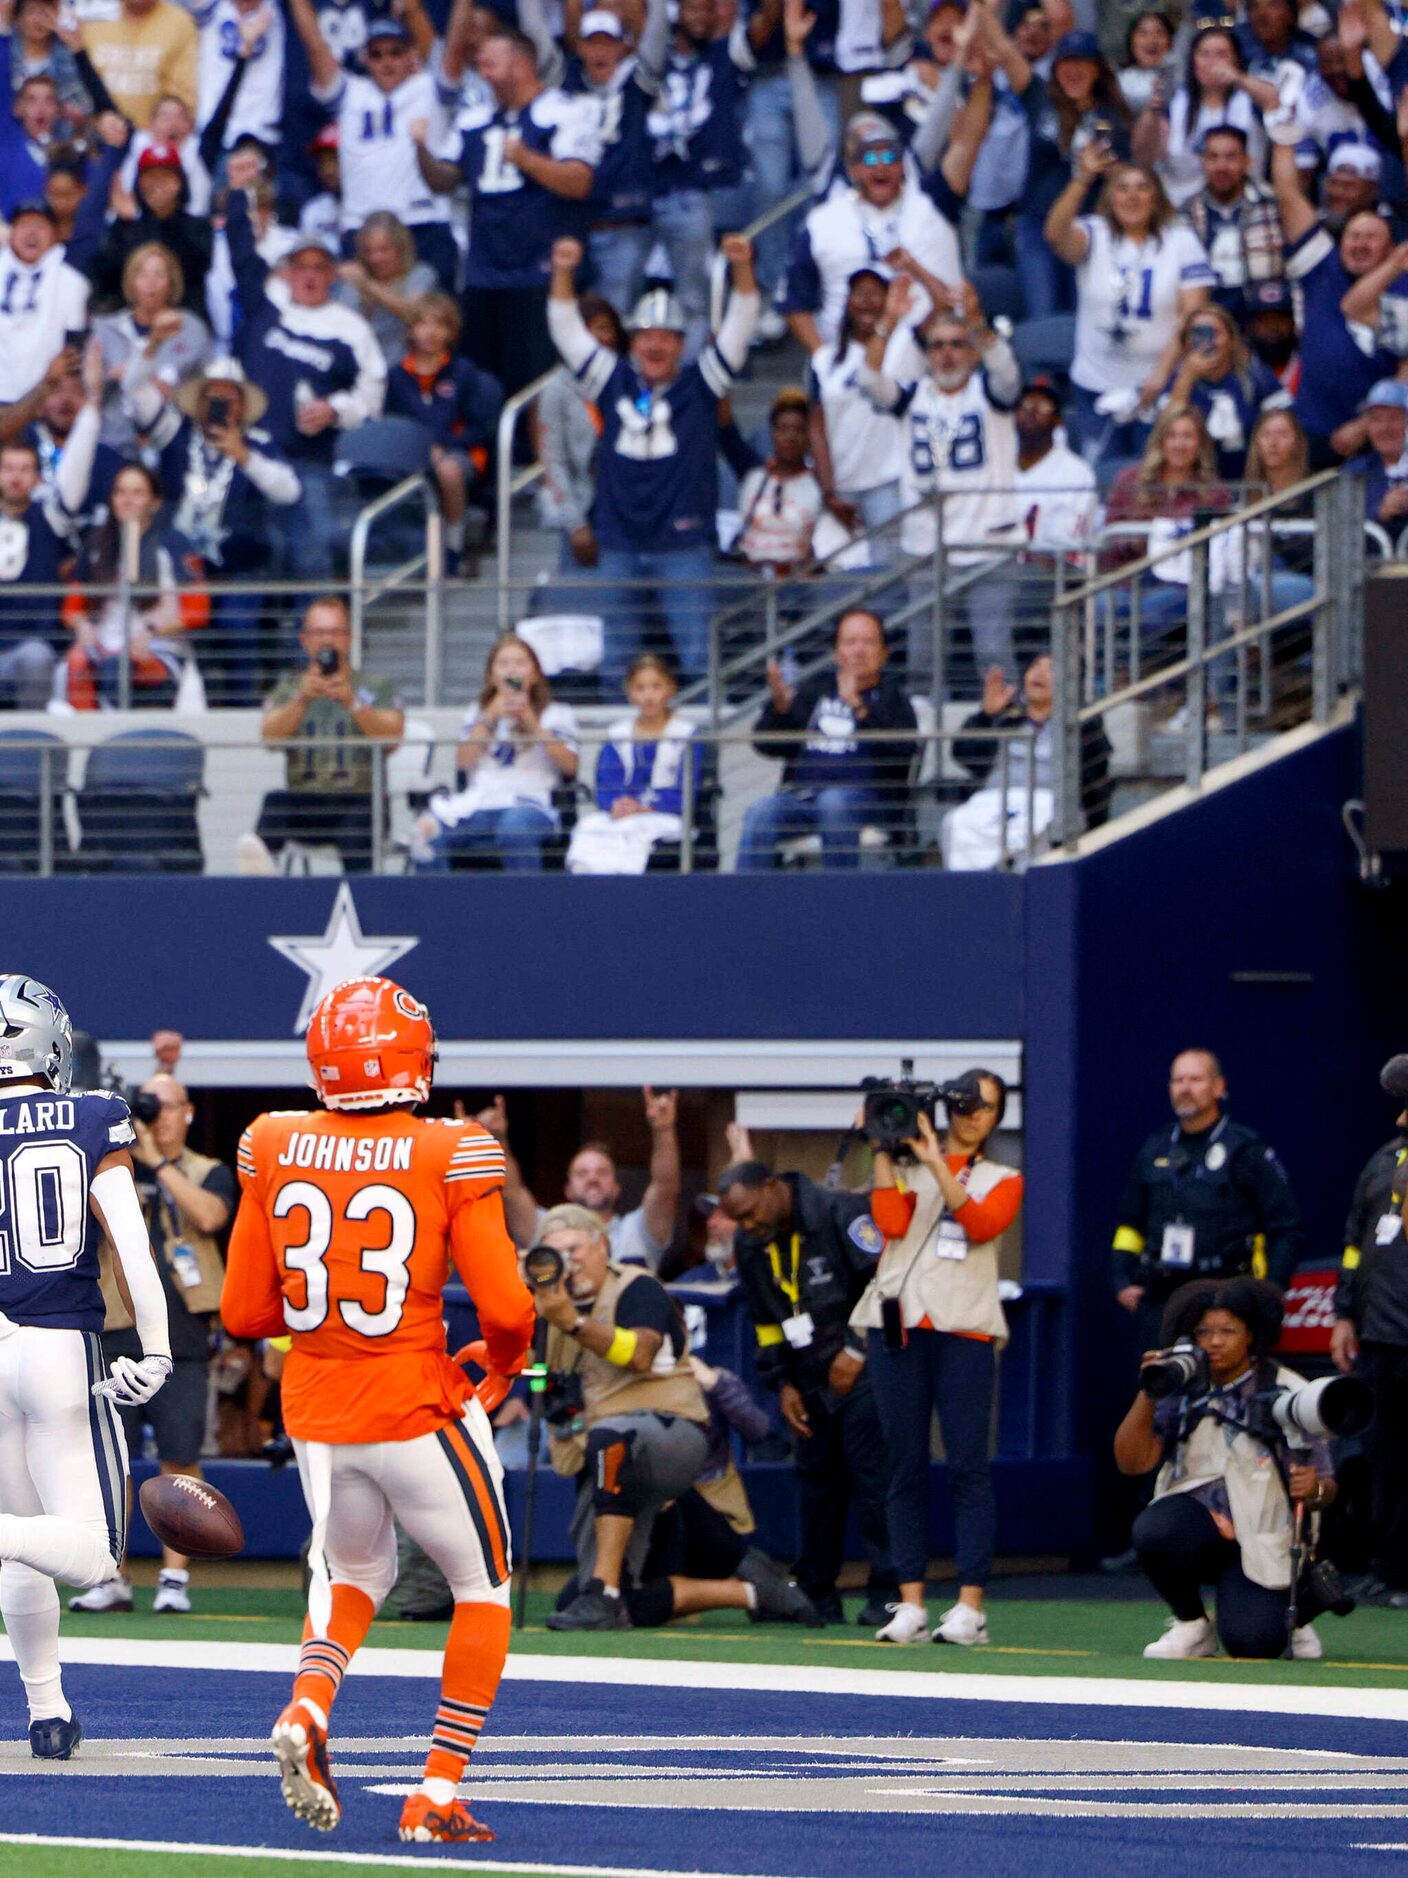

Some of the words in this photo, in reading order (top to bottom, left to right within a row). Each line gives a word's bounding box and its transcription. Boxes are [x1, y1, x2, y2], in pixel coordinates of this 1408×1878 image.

[361, 101, 393, 139] 11
[277, 1131, 414, 1172] JOHNSON
[273, 1179, 417, 1338] 33
